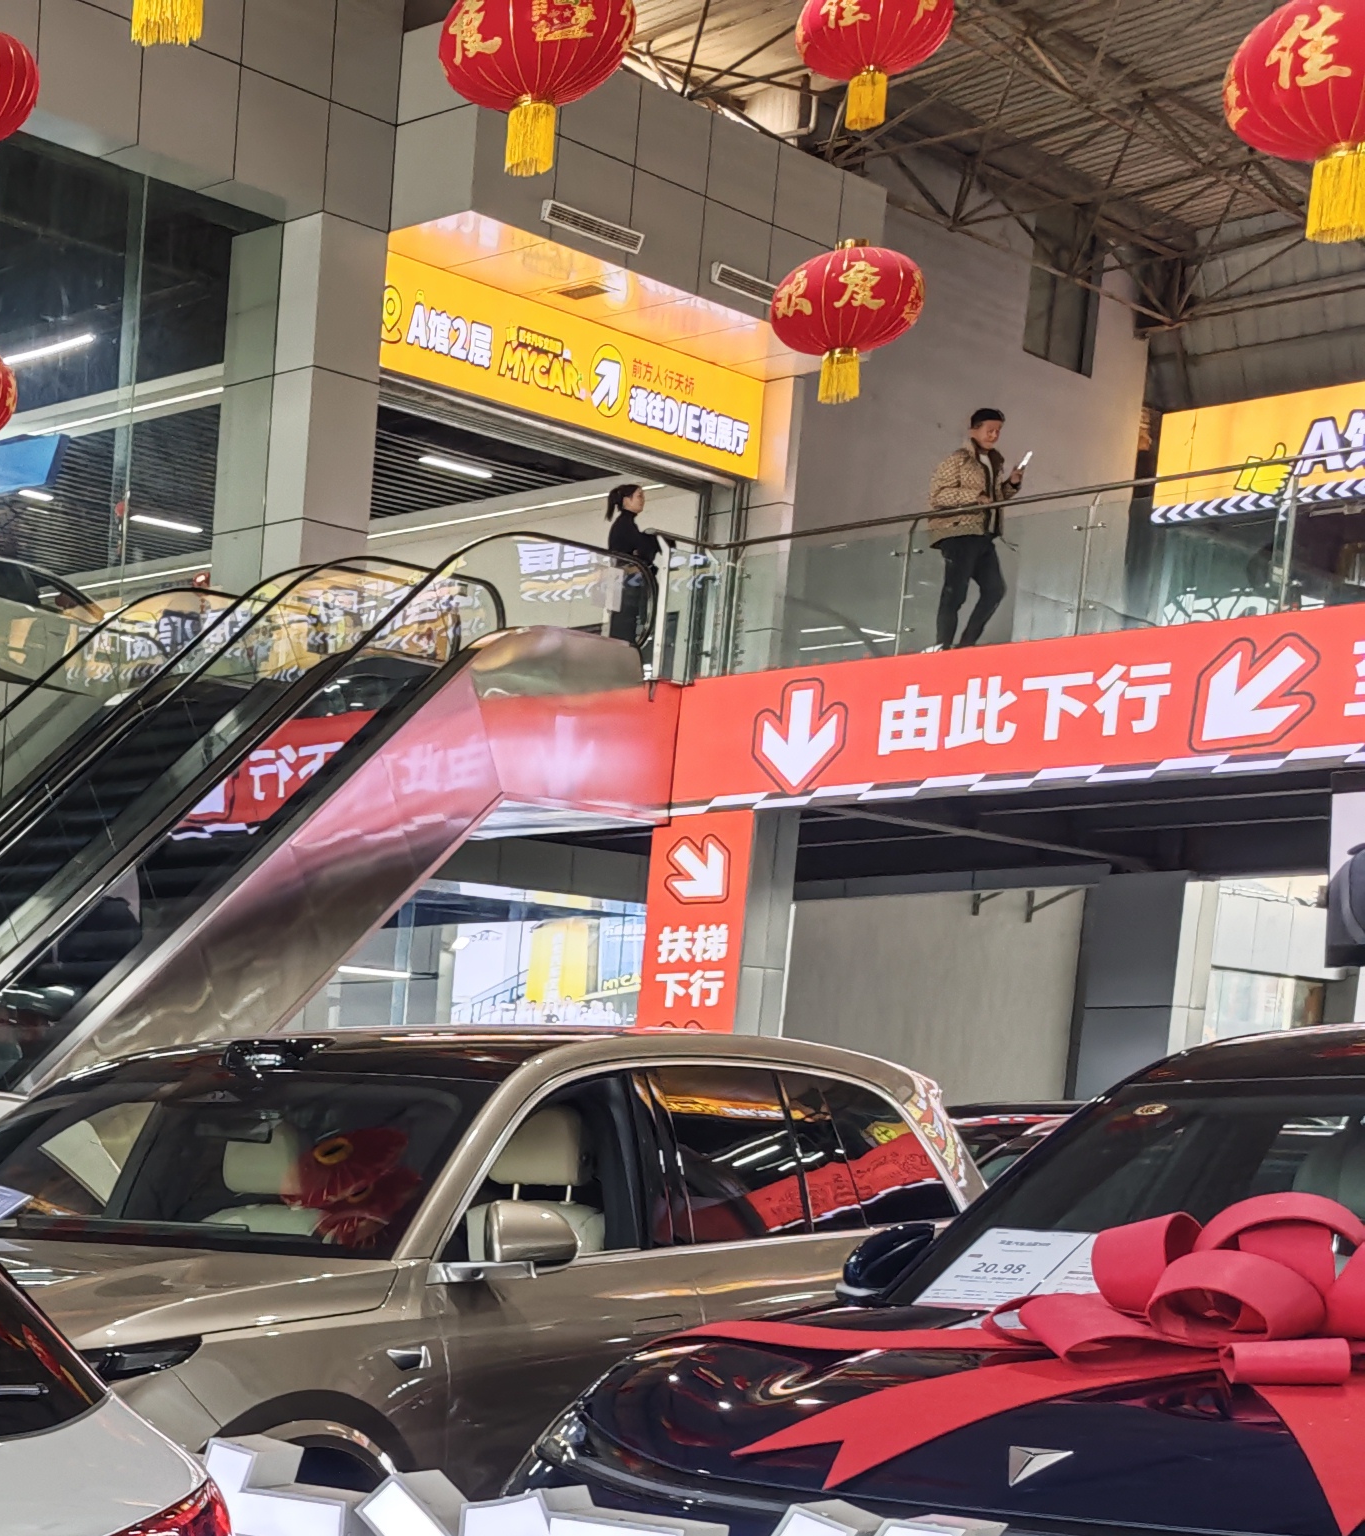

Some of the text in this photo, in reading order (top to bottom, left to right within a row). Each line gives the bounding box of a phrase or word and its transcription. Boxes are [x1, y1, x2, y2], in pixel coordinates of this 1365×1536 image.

[405, 302, 493, 369] A馆2层
[497, 340, 585, 402] MYCAR
[631, 357, 696, 397] 前方人行天桥
[876, 661, 1173, 757] 由此下行
[657, 924, 730, 963] 扶梯
[654, 969, 727, 1009] 下行
[971, 1262, 1027, 1275] 20.98
